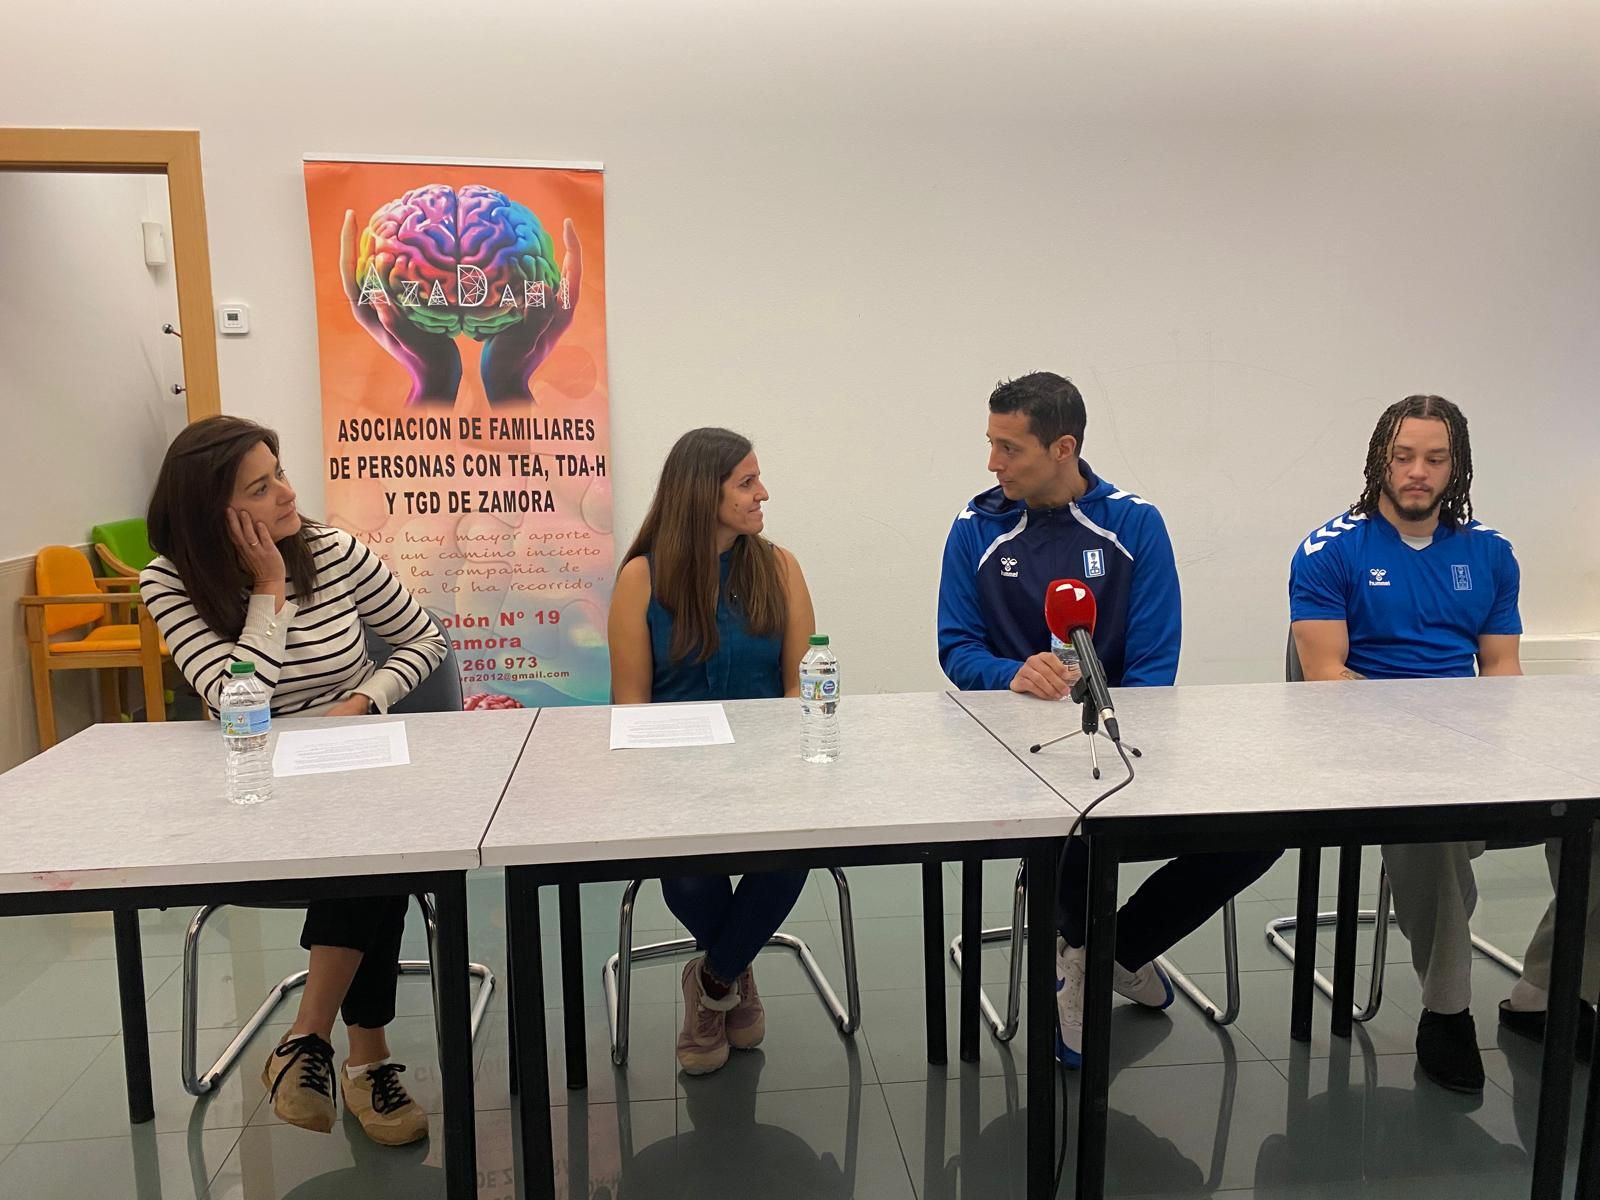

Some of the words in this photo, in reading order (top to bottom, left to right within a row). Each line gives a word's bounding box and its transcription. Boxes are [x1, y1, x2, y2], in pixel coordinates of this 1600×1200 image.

[338, 417, 451, 442] ASOCIACION
[458, 417, 482, 440] DE
[489, 417, 595, 441] FAMILIARES
[329, 457, 351, 480] DE
[357, 454, 456, 479] PERSONAS
[462, 454, 501, 477] CON
[508, 454, 549, 482] TEA,
[555, 454, 606, 477] TDA-H
[385, 492, 396, 515] Y
[404, 491, 441, 515] TGD
[448, 490, 471, 514] DE
[478, 490, 555, 513] ZAMORA
[405, 532, 445, 546] hay
[456, 531, 520, 544] mayor
[528, 531, 592, 544] aporte
[400, 552, 431, 560] un
[438, 548, 517, 560] camino
[526, 547, 601, 557] incierto
[410, 566, 434, 577] la
[559, 562, 581, 573] de
[441, 582, 462, 593] lo
[471, 581, 500, 592] ha
[440, 613, 490, 629] olón
[535, 610, 561, 625] 19
[451, 636, 522, 651] amora
[463, 659, 497, 672] 260
[504, 656, 538, 671] 973
[460, 670, 570, 683] ra2012@gmail.com
